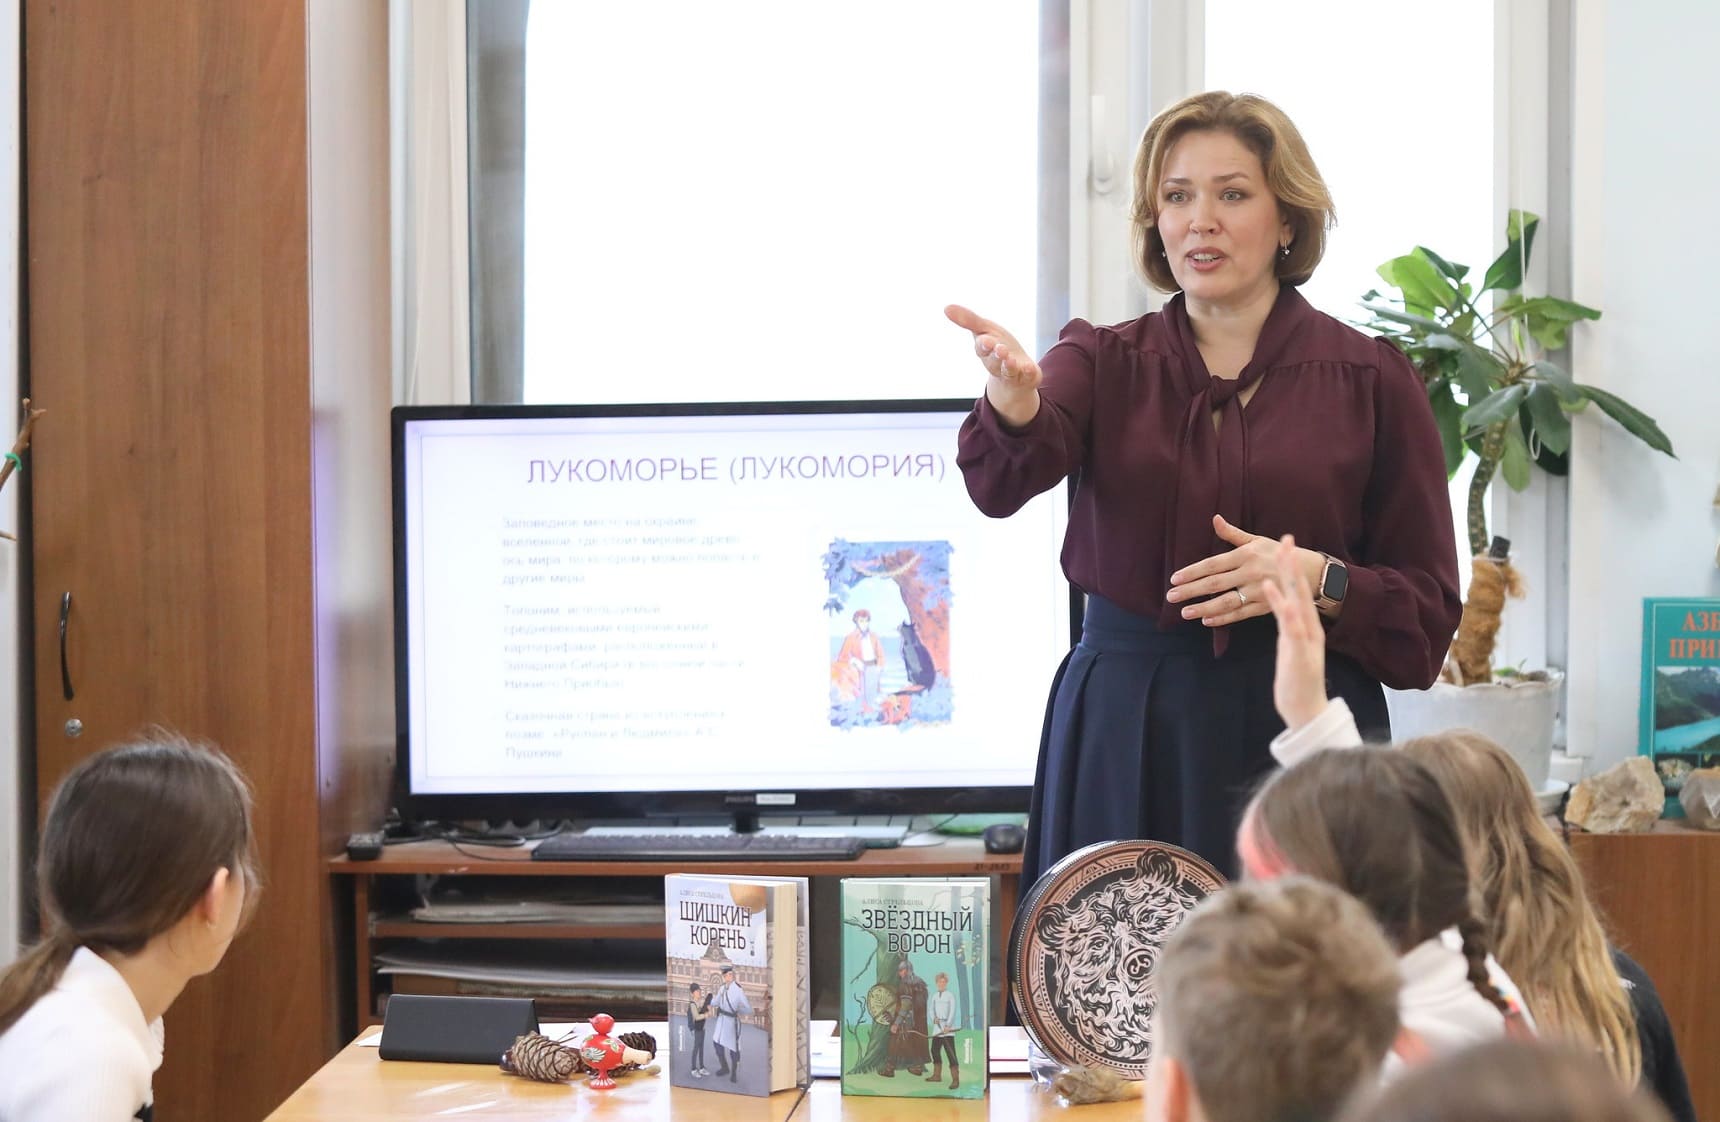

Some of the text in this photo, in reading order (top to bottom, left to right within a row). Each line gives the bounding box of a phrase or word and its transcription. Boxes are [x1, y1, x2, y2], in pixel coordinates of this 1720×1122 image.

[527, 453, 946, 485] ЛУКОМОРЬЕ (ЛУКОМОРИЯ)
[503, 516, 577, 529] Заповедное
[1668, 638, 1720, 659] ПРИ
[679, 900, 752, 928] ШИШКИН
[861, 905, 973, 932] ЗВЁЗДНЫЙ
[691, 925, 746, 950] КОРЕНЬ
[888, 933, 951, 954] ВОРОН
